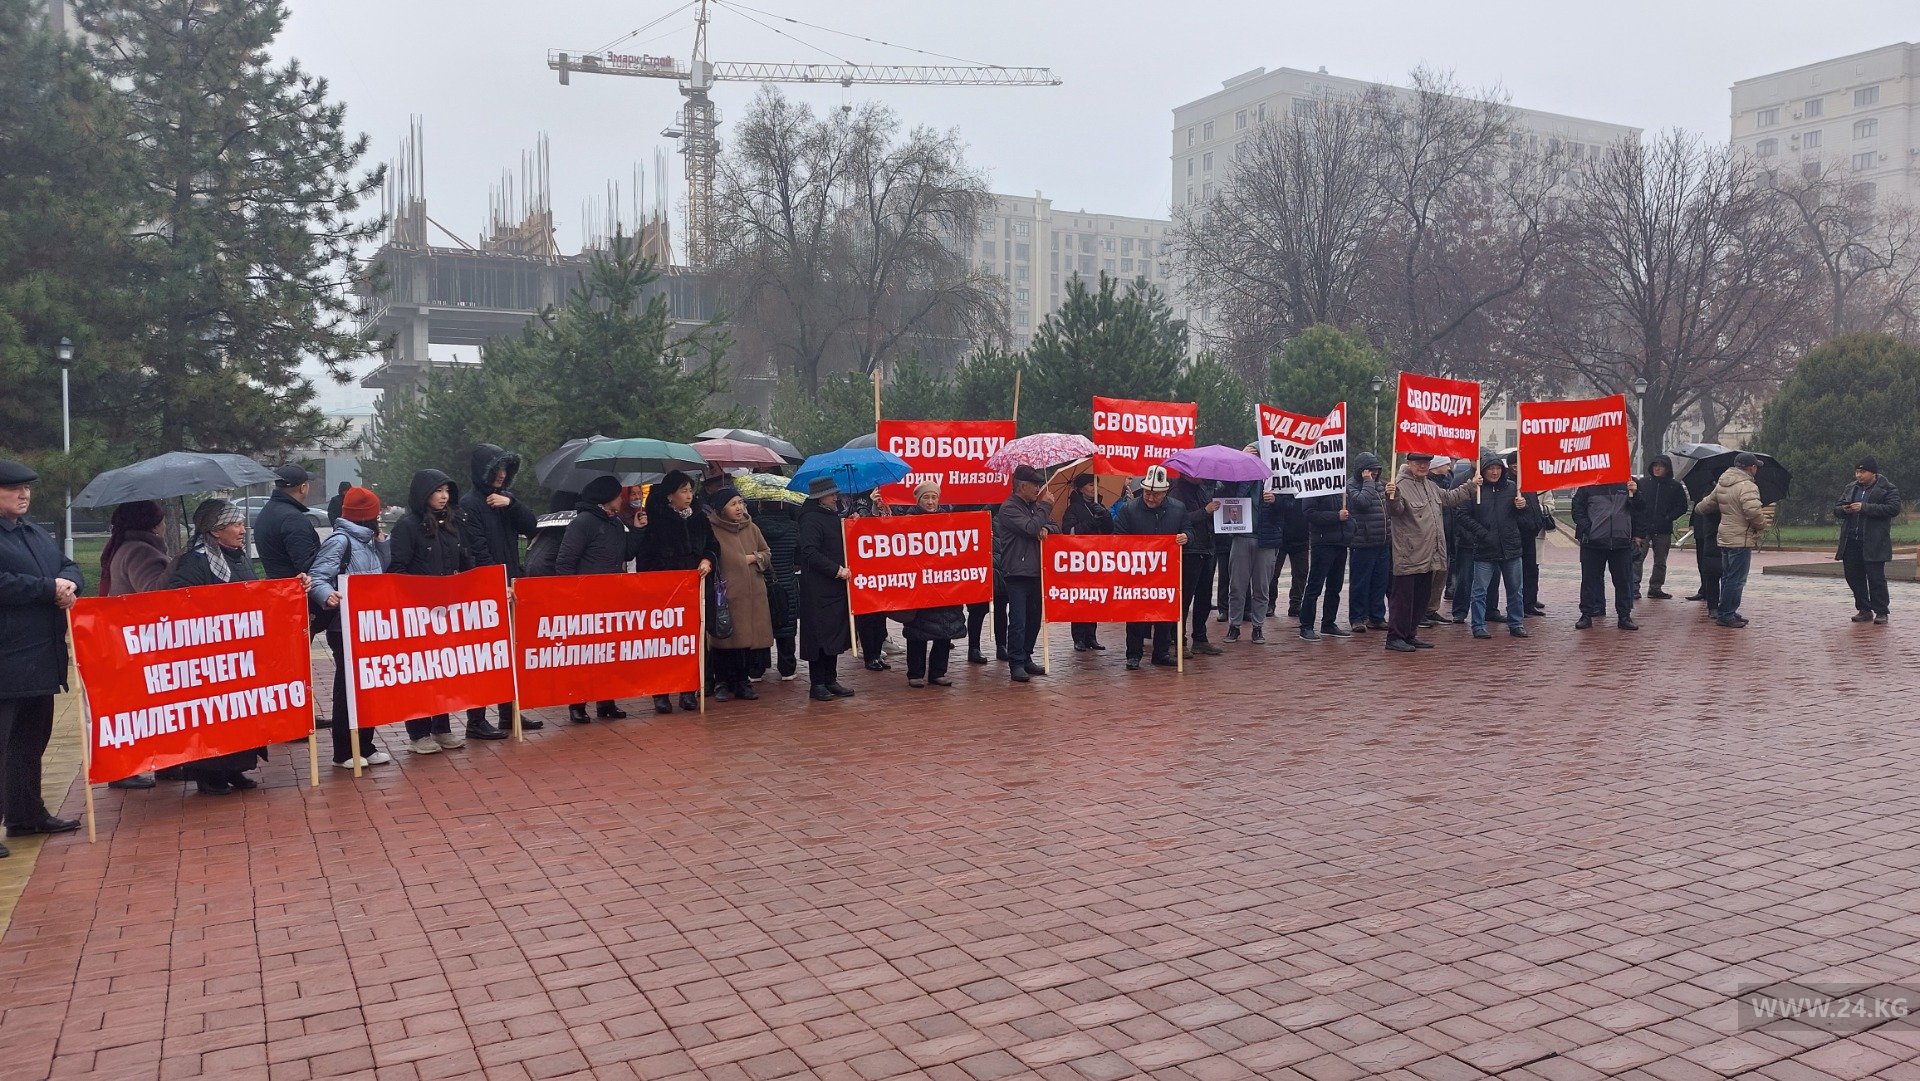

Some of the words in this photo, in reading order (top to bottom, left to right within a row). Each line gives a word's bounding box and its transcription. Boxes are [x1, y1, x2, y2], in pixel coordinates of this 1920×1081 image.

[1407, 388, 1472, 417] СВОБОДУ!
[1093, 411, 1194, 437] СВОБОДУ!
[1400, 419, 1436, 439] Фариду
[1522, 417, 1570, 435] СОТТОР
[1097, 444, 1139, 460] ариду
[1538, 453, 1611, 475] ЧЫГАРГЫЛА!
[857, 529, 979, 559] СВОБОДУ!
[1054, 551, 1168, 575] СВОБОДУ!
[853, 572, 917, 592] Фариду
[922, 566, 988, 585] Ниязову
[1048, 586, 1108, 603] Фариду
[1112, 586, 1175, 603] Ниязову
[358, 608, 399, 642] МЫ
[402, 599, 500, 638] ПРОТИВ
[650, 607, 685, 630] СОТ
[122, 610, 264, 655] БИЙЛИКТИН
[358, 639, 509, 690] БЕЗЗАКОНИЯ
[525, 642, 615, 669] БИЙЛИКЕ
[619, 635, 696, 661] НАМЫС!
[143, 650, 256, 694] КЕЛЕЧЕГИ
